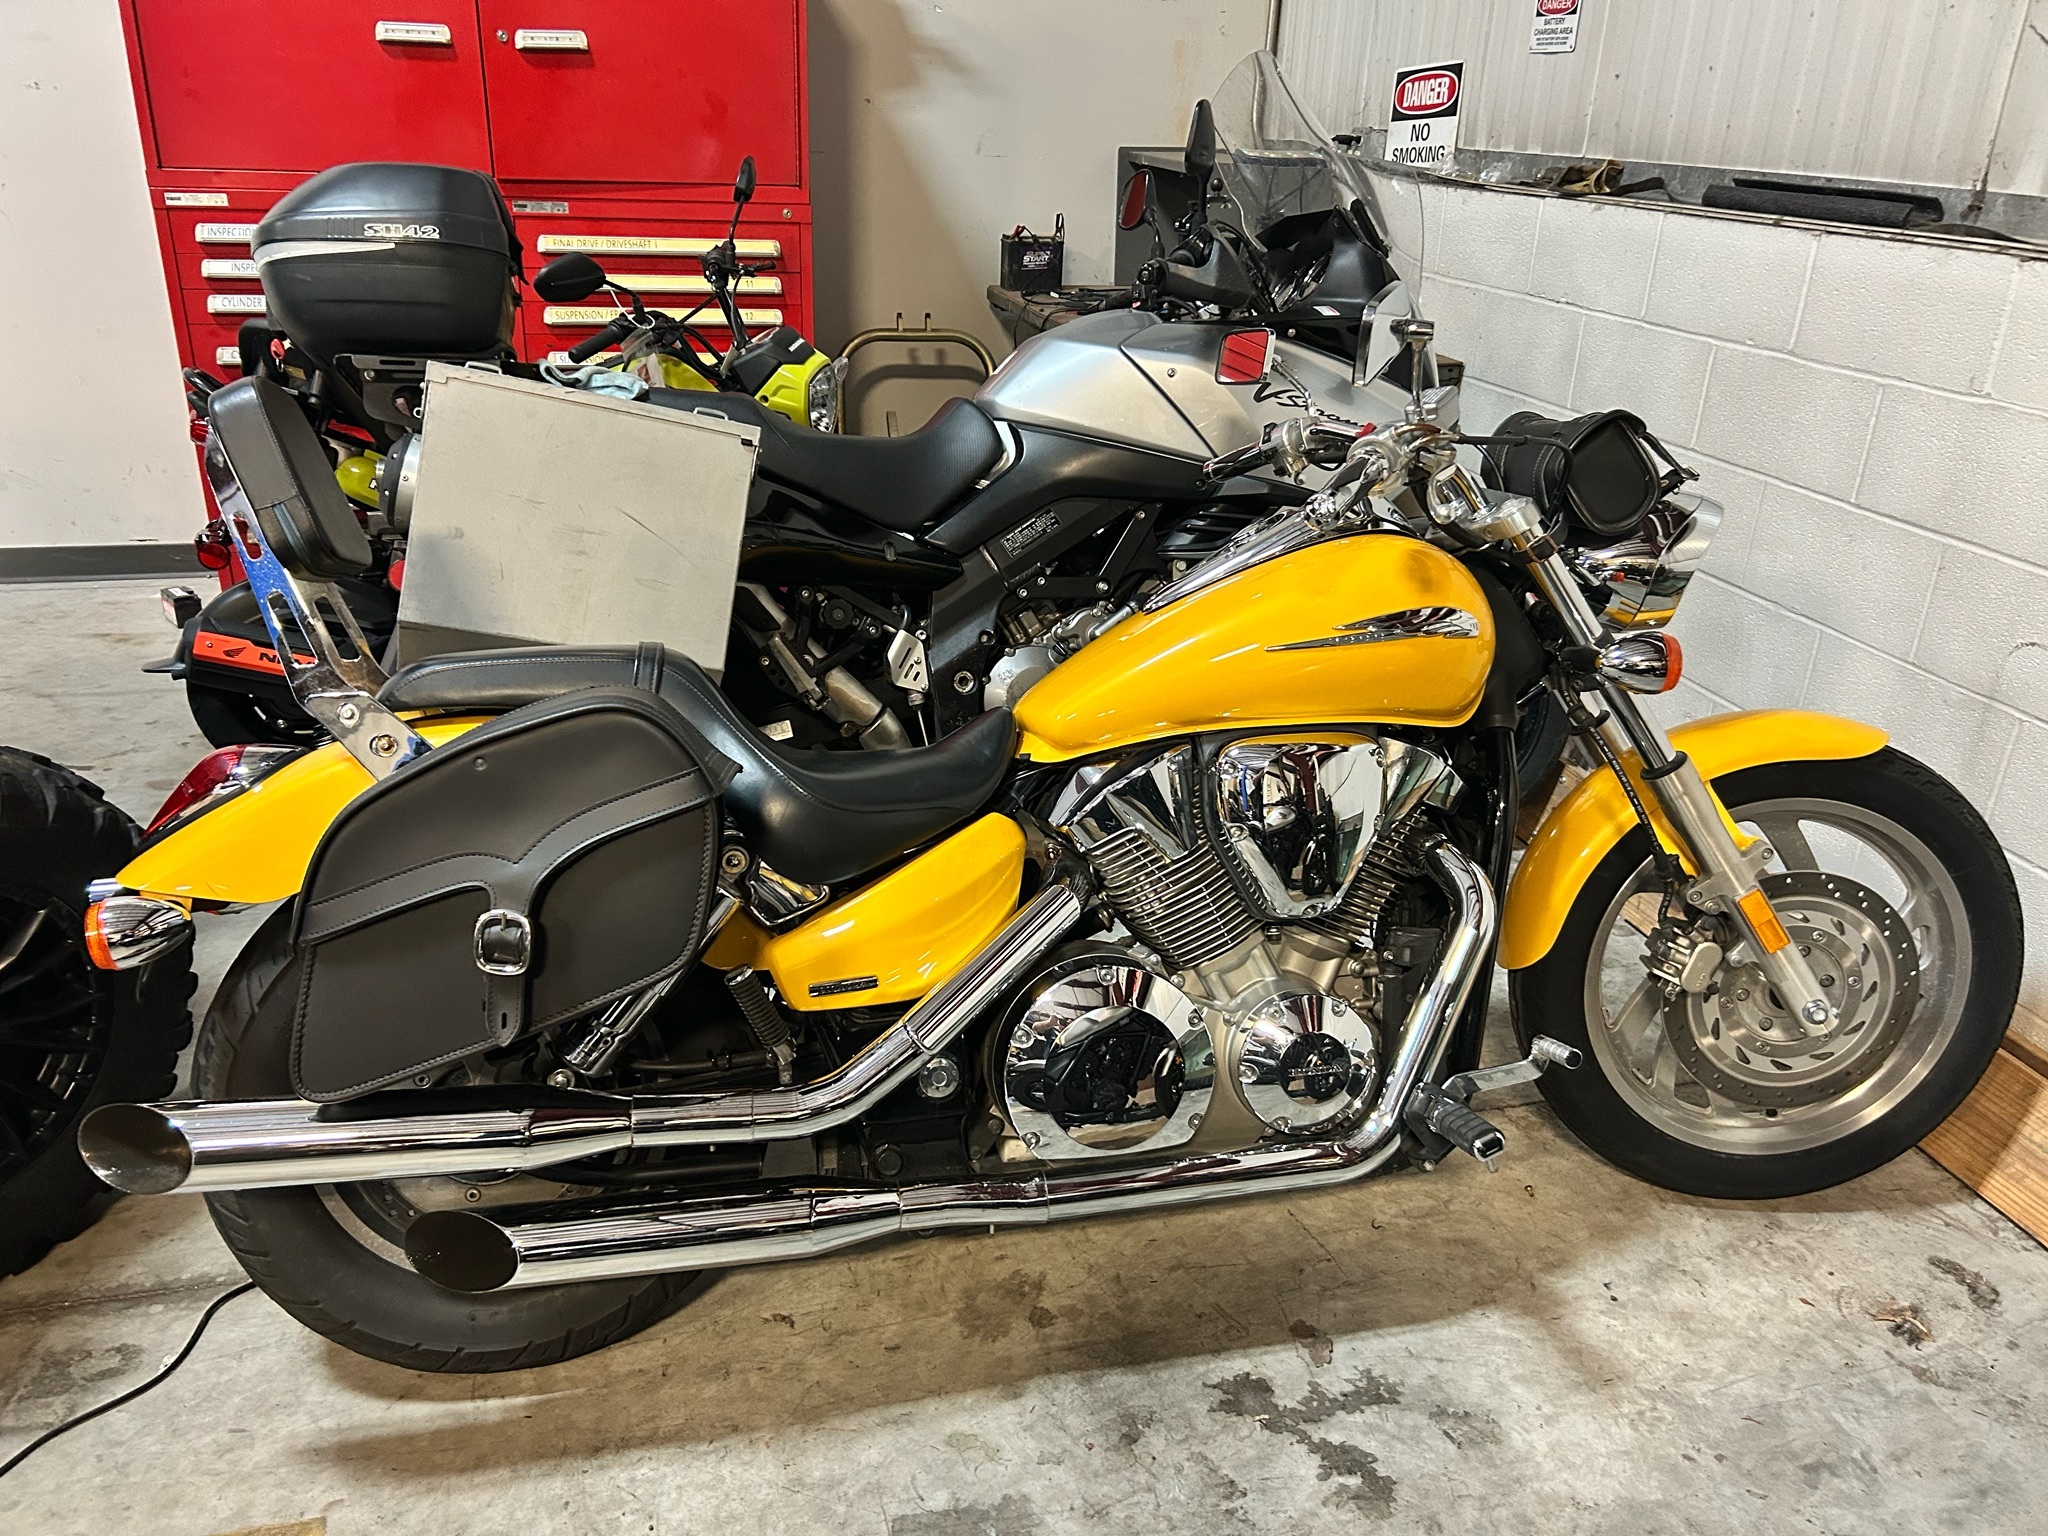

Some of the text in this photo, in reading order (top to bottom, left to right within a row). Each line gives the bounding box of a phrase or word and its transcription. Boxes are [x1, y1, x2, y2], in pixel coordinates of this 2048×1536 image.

[1541, 0, 1572, 10] DANGER
[1543, 17, 1566, 26] BATTERY
[1534, 26, 1573, 36] CHARGING AREA
[1402, 76, 1450, 108] DANGER
[1410, 122, 1431, 142] NO
[1392, 145, 1445, 163] SMOKING
[363, 223, 440, 239] SH42
[553, 238, 574, 248] FINAL
[576, 238, 599, 248] DRIVE
[606, 239, 652, 249] DRIVESHAFT
[1022, 255, 1050, 263] START
[231, 262, 255, 272] INSPE
[745, 279, 754, 288] 11
[221, 296, 263, 308] CYLINDER
[555, 309, 604, 320] SUSPENSION
[745, 311, 754, 321] 12
